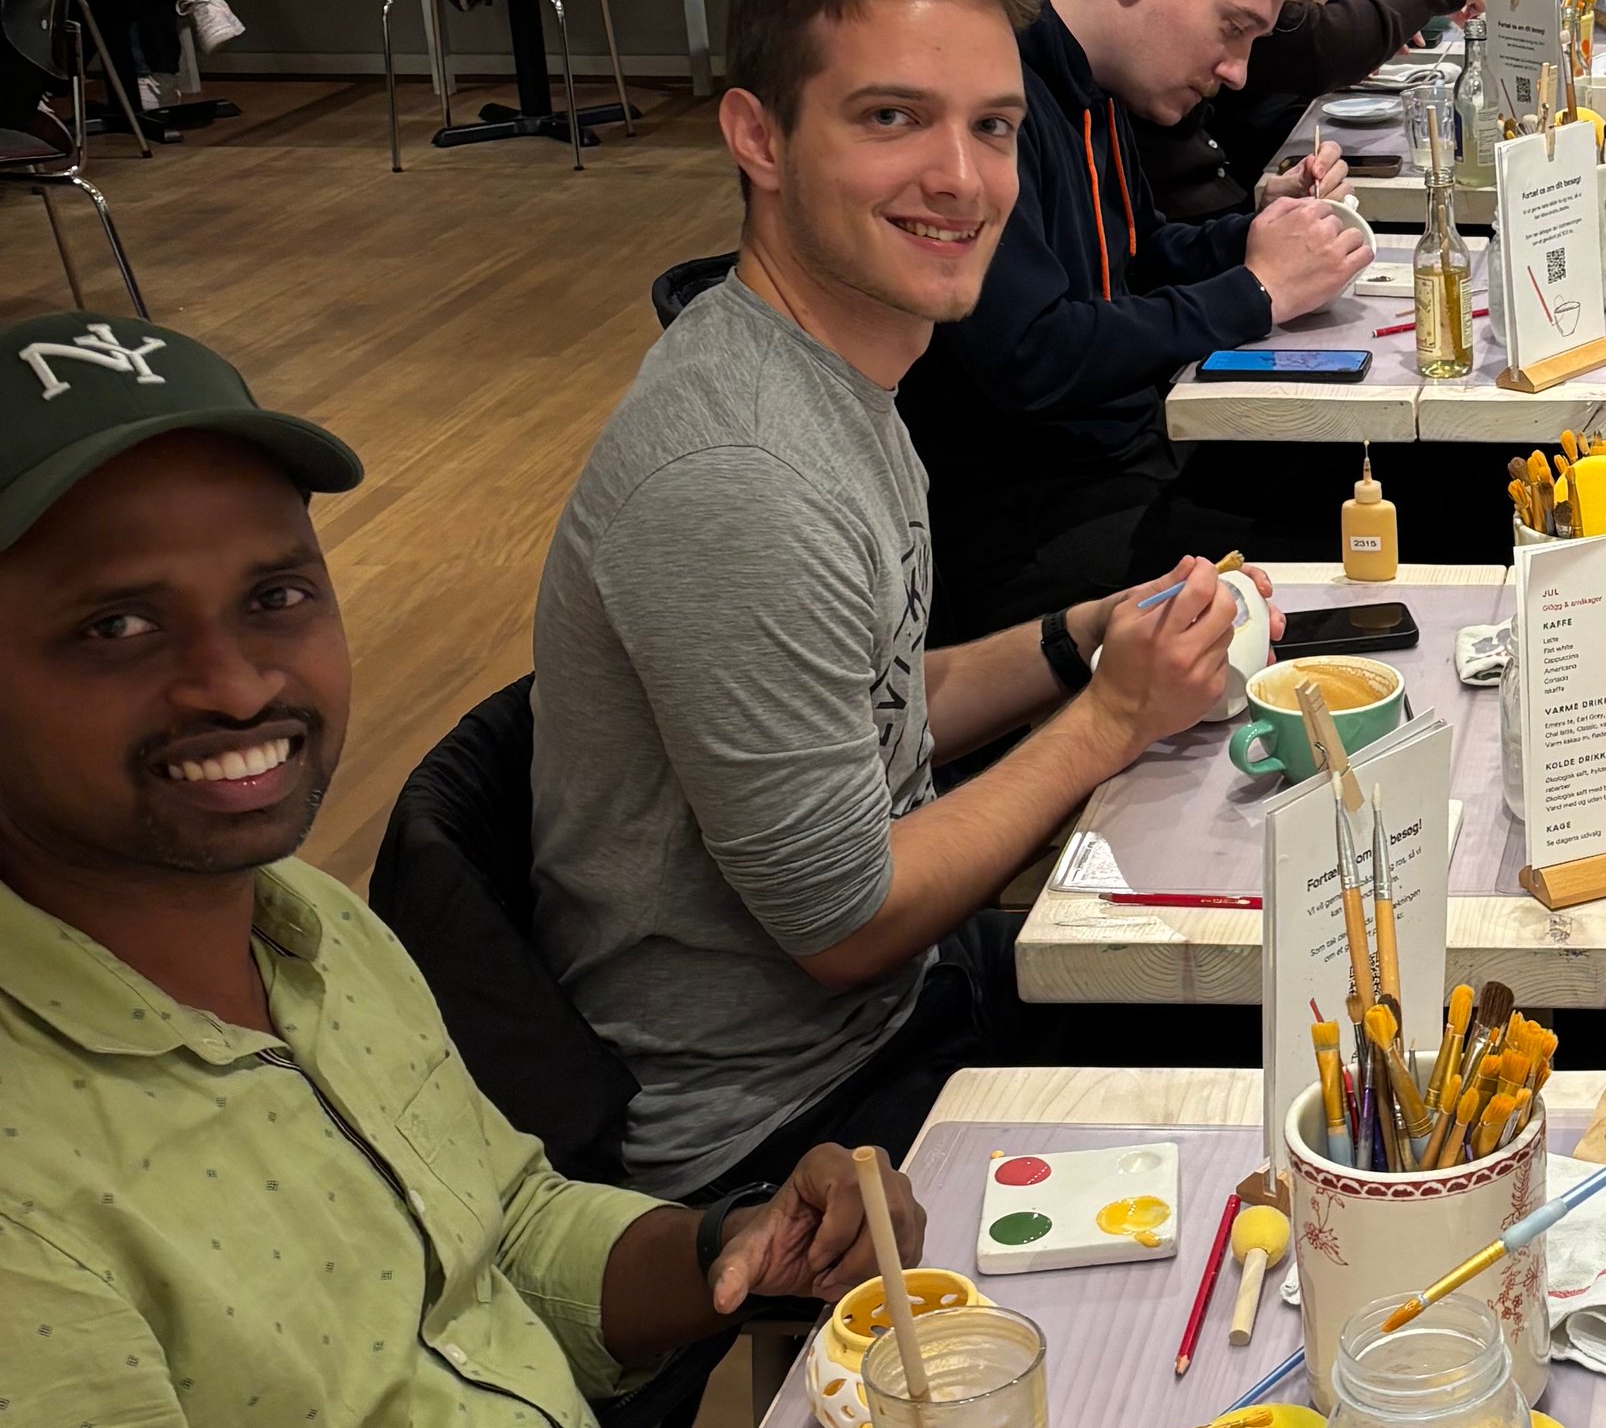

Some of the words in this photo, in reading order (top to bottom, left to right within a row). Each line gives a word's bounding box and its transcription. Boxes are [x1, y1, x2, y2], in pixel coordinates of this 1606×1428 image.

[18, 324, 167, 401] NY
[1542, 589, 1559, 597] JUL
[1543, 618, 1572, 629] KAFFE
[1545, 703, 1578, 715] VARME
[1545, 758, 1575, 771] KOLDE
[1546, 821, 1571, 833] KAGE
[1356, 849, 1371, 864] om
[1390, 818, 1422, 845] besøg!
